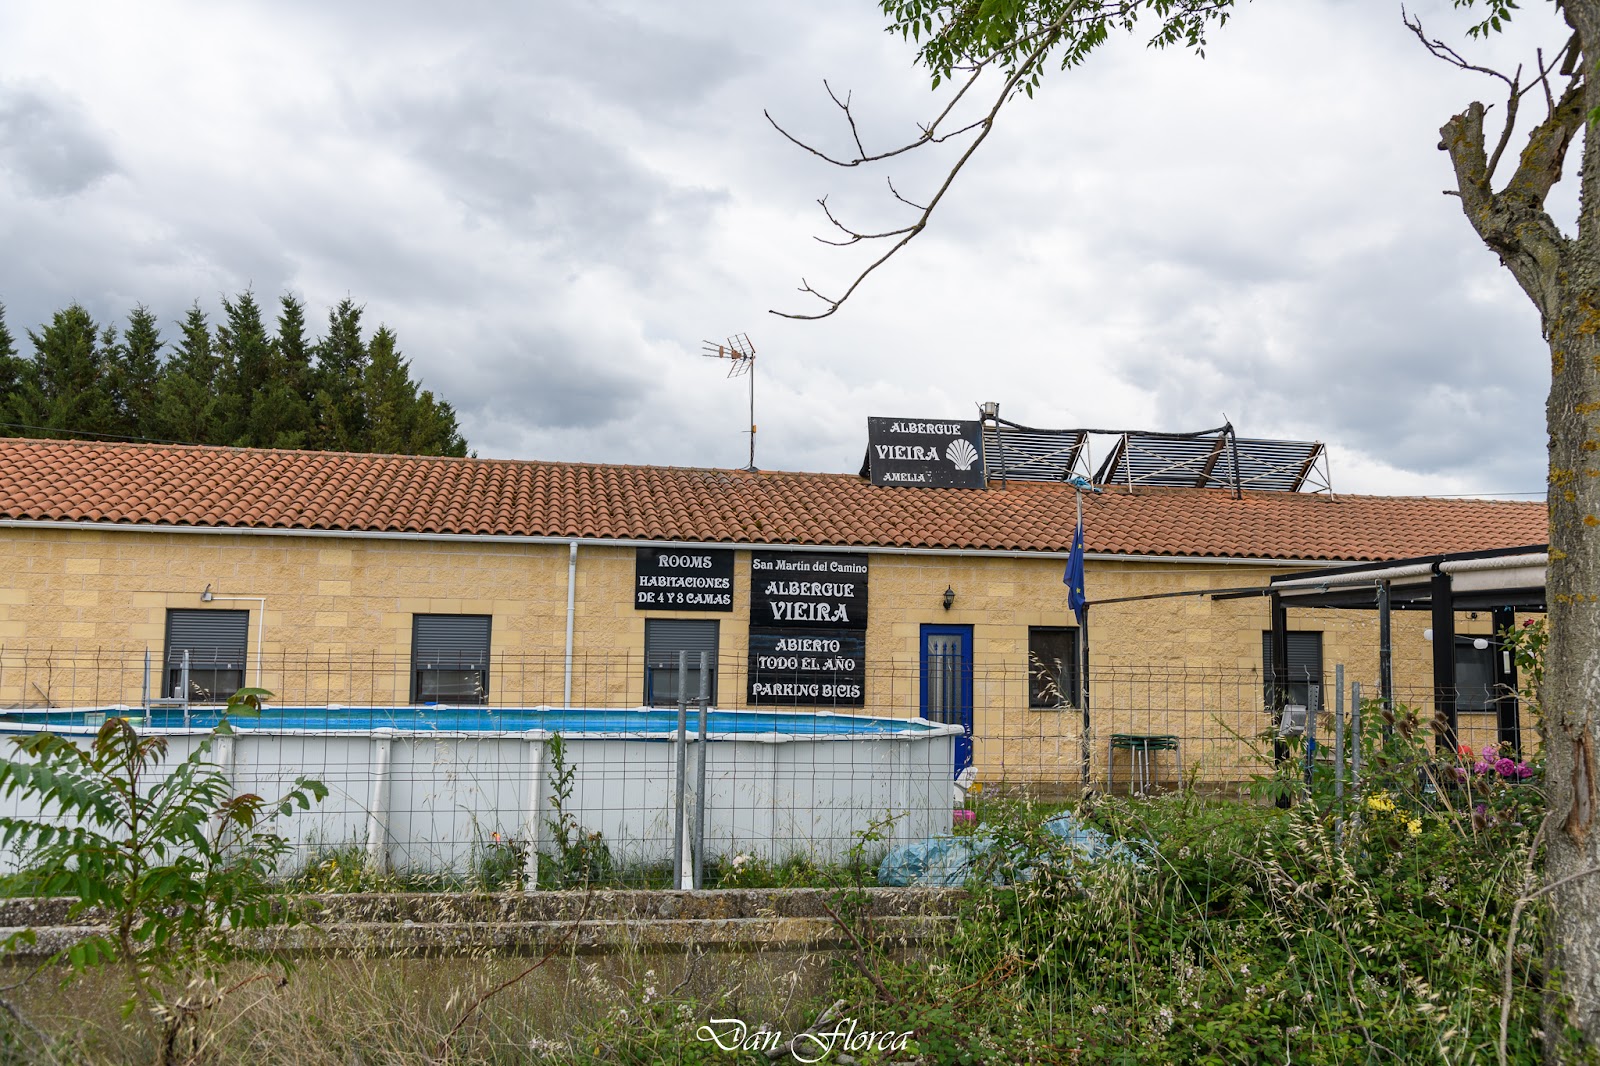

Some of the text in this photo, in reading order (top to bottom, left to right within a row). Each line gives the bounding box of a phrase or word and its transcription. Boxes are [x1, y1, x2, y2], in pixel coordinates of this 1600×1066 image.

[890, 422, 961, 435] ALBERGUE
[875, 444, 940, 461] VIEIRA
[883, 472, 926, 483] AMELIA
[658, 554, 713, 569] ROOMS
[752, 558, 868, 573] San Martin del Camino
[639, 575, 730, 589] HABITACIONES
[764, 581, 855, 598] ALBERGUE
[637, 591, 731, 605] DE 4 Y 8 CAMAS
[769, 602, 850, 622] VIEIRA
[775, 638, 841, 653] ABIERTO
[758, 655, 856, 671] TODO EL AÑO
[752, 682, 861, 698] PARKING BICIS
